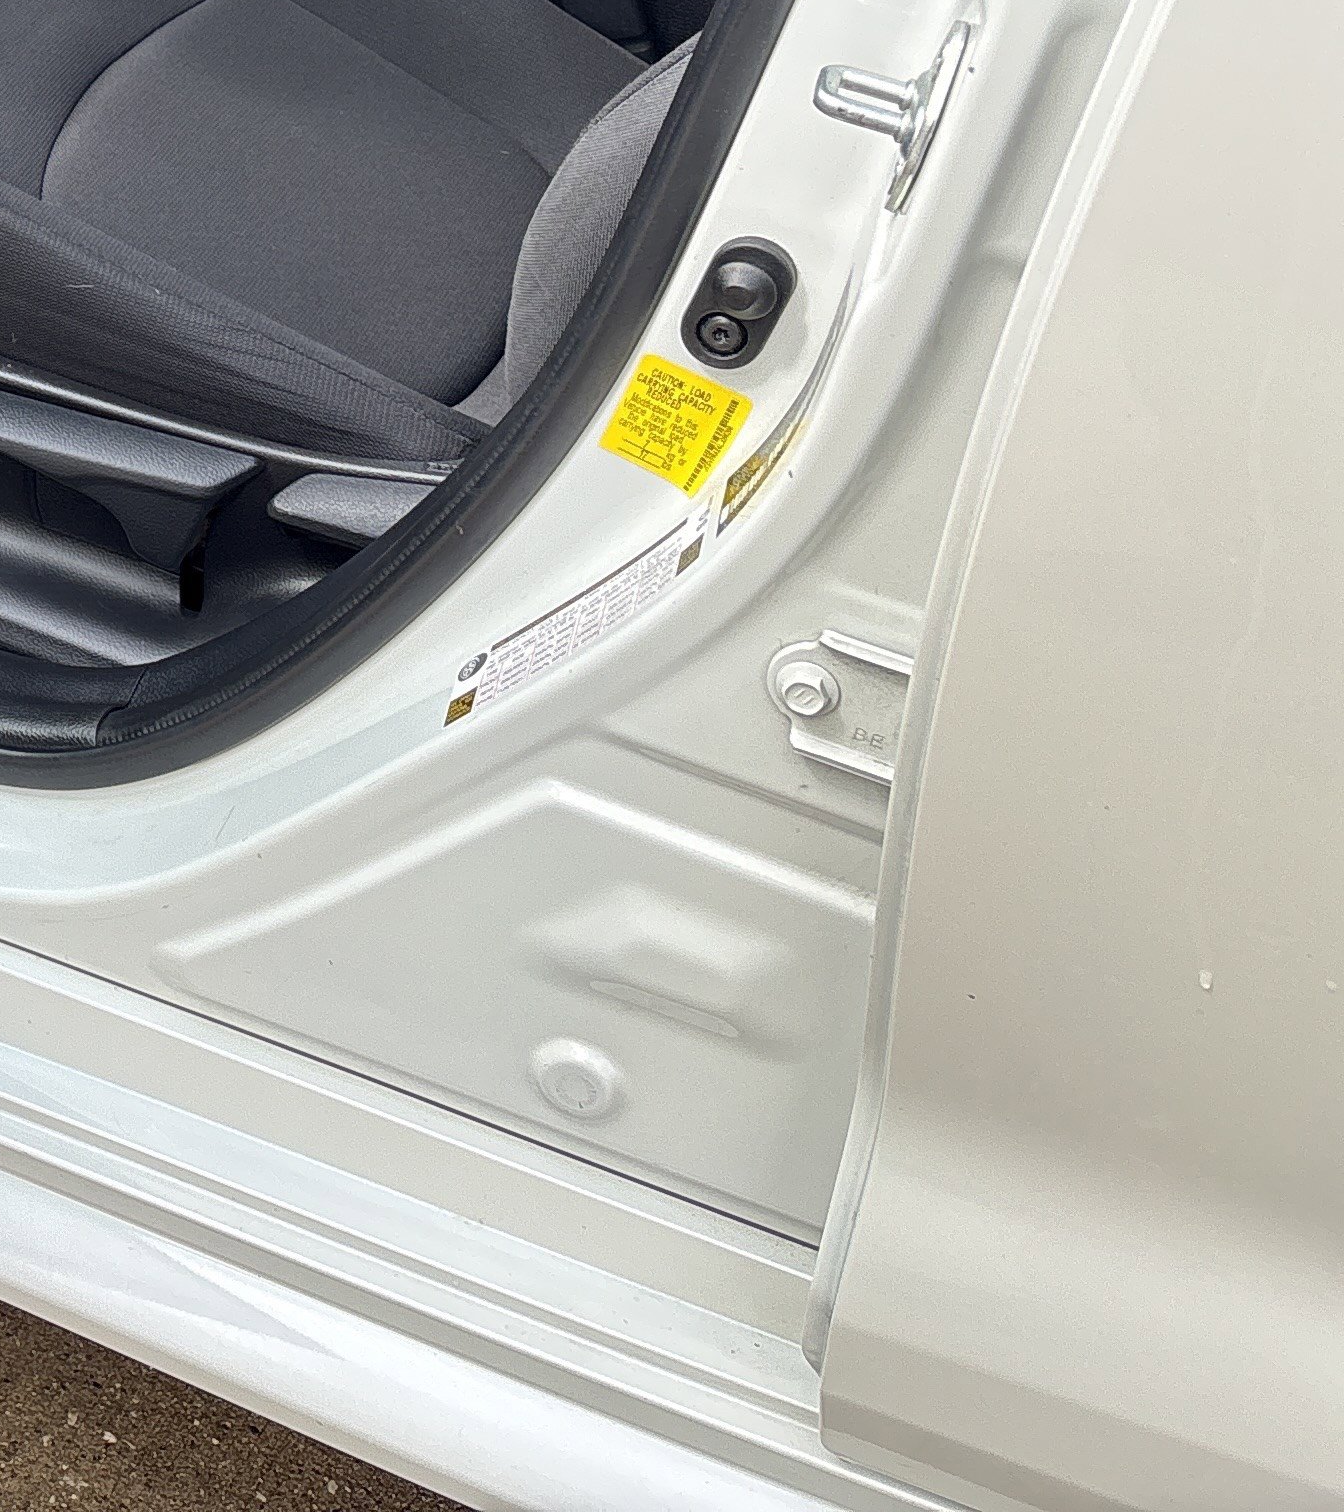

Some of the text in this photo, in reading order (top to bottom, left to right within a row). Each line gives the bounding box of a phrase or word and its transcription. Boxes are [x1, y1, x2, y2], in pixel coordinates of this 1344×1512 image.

[637, 373, 717, 415] CARRYING CAPACITY
[646, 386, 681, 410] REDUCED
[690, 385, 711, 402] LOAD
